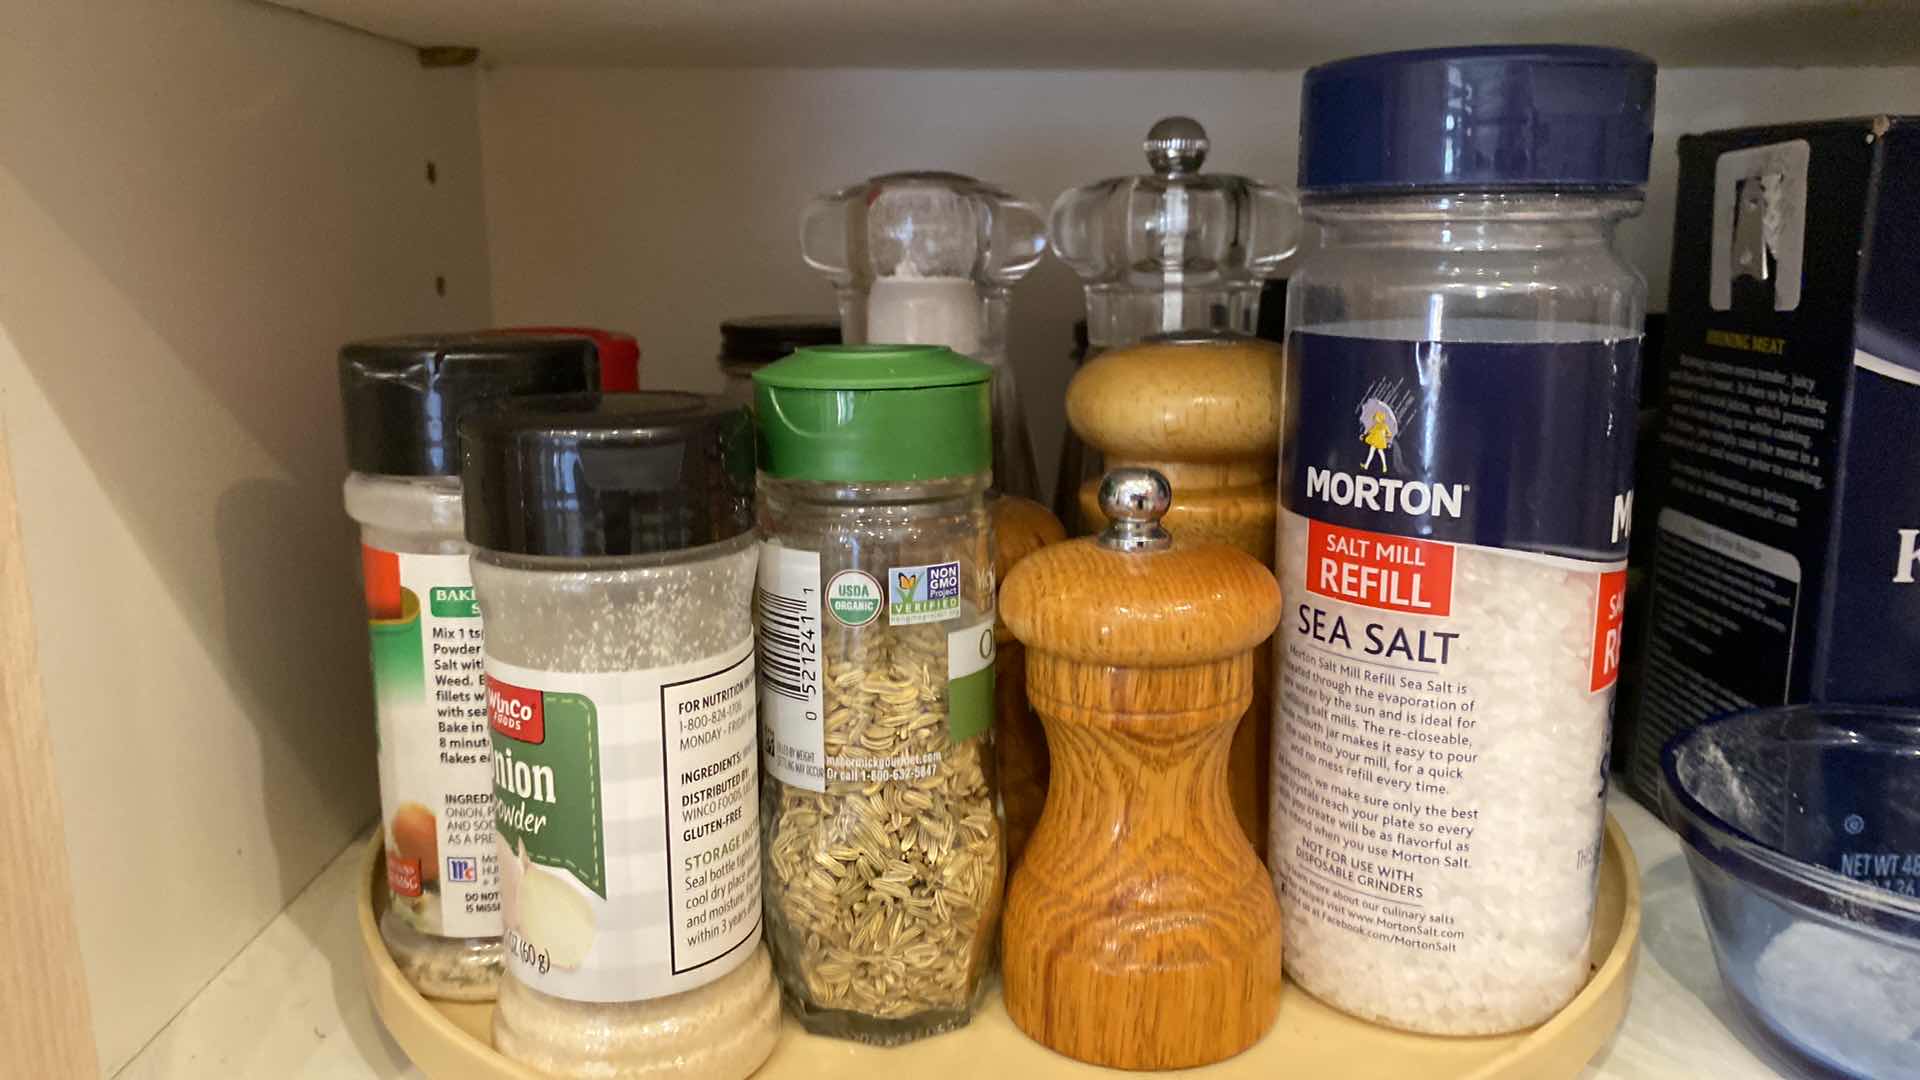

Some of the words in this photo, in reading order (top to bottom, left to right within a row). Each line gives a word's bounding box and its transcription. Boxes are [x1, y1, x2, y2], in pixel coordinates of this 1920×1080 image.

[1306, 465, 1463, 518] MORTON
[1327, 533, 1370, 559] SALT
[1376, 542, 1425, 567] MILL
[929, 577, 958, 590] GMO
[930, 566, 958, 579] NON
[1320, 556, 1432, 608] REFILL
[838, 583, 870, 597] USDA
[929, 588, 958, 600] Project
[834, 600, 875, 612] ORGANIC
[895, 597, 959, 614] VERIFIED
[433, 627, 455, 639] Mix
[459, 628, 464, 639] 1
[1298, 603, 1352, 650] SEA
[1364, 622, 1460, 665] SALT
[433, 643, 481, 655] Powder
[434, 658, 457, 671] Salt
[1319, 656, 1337, 673] Salt
[1340, 664, 1360, 679] Mill
[1365, 670, 1395, 687] Refill
[1400, 676, 1422, 690] Sea
[1427, 680, 1452, 694] Salt
[1457, 681, 1467, 694] is
[435, 674, 473, 686] Weed.
[1313, 673, 1351, 695] through
[1355, 684, 1374, 699] the
[1378, 692, 1456, 712] evaporation
[1461, 700, 1475, 713] of
[436, 689, 471, 702] fillets
[486, 684, 532, 721] WinCo
[679, 699, 700, 715] FOR
[702, 680, 744, 709] NUTRITION
[1319, 689, 1331, 705] by
[1334, 697, 1352, 710] the
[1354, 703, 1375, 717] sun
[1379, 709, 1402, 722] and
[1406, 711, 1416, 723] is
[1421, 713, 1452, 728] ideal
[1457, 716, 1476, 729] for
[437, 706, 464, 718] with
[493, 712, 521, 731] FOODS
[805, 711, 817, 721] 0
[438, 721, 468, 733] Bake
[471, 720, 483, 732] in
[680, 728, 722, 751] MONDAY
[1363, 719, 1385, 735] The
[1388, 727, 1472, 750] re-closeable,
[439, 737, 446, 748] 8
[1325, 725, 1339, 740] jar
[1342, 733, 1378, 750] makes
[1382, 740, 1391, 753] it
[1395, 745, 1424, 761] easy
[1429, 749, 1443, 761] to
[1447, 752, 1478, 765] pour
[440, 752, 476, 764] flakes
[1313, 738, 1333, 754] into
[1336, 746, 1361, 760] your
[1395, 759, 1412, 773] for
[1417, 766, 1424, 775] a
[1428, 767, 1463, 781] quick
[1305, 751, 1317, 763] no
[1319, 757, 1343, 775] mess
[1346, 767, 1373, 783] refill
[1376, 775, 1412, 793] every
[1416, 781, 1449, 795] time.
[682, 774, 741, 807] DISTRIBUTED
[1315, 779, 1328, 790] we
[1331, 784, 1360, 801] make
[1364, 795, 1389, 808] sure
[1392, 801, 1421, 817] only
[1426, 804, 1447, 817] the
[1451, 805, 1479, 820] best
[682, 800, 717, 823] WINCO
[683, 805, 743, 842] GLUTEN-FREE
[1321, 797, 1349, 813] reach
[1352, 807, 1378, 822] your
[1382, 815, 1415, 830] plate
[1419, 823, 1433, 832] so
[1438, 824, 1473, 839] every
[447, 820, 471, 833] AND
[448, 833, 461, 845] AS
[464, 834, 471, 845] A
[1307, 805, 1335, 825] create
[1339, 818, 1358, 833] will
[1362, 823, 1376, 837] be
[1379, 832, 1392, 842] as
[1397, 832, 1452, 851] flavorful
[1456, 842, 1470, 852] as
[685, 837, 740, 871] STORAGE
[1314, 825, 1340, 843] when
[1343, 837, 1364, 851] you
[1368, 845, 1388, 857] use
[1391, 848, 1440, 865] Morton
[1296, 845, 1353, 881] DISPOSABLE
[1357, 874, 1423, 898] GRINDERS
[1302, 836, 1323, 855] NOT
[1325, 848, 1347, 865] FOR
[1351, 858, 1373, 874] USE
[1377, 865, 1414, 882] WITH
[1841, 853, 1872, 877] NET
[1874, 854, 1900, 877] WT
[685, 871, 708, 890] Seal
[710, 858, 736, 879] bottle
[465, 892, 478, 902] DO
[686, 890, 709, 910] cool
[711, 883, 726, 899] dry
[1327, 900, 1345, 915] visit
[1333, 890, 1359, 906] about
[1361, 900, 1378, 912] our
[1382, 904, 1426, 923] culinary
[1429, 913, 1455, 925] salts
[686, 909, 707, 928] and
[688, 925, 720, 947] within
[721, 919, 727, 934] 3
